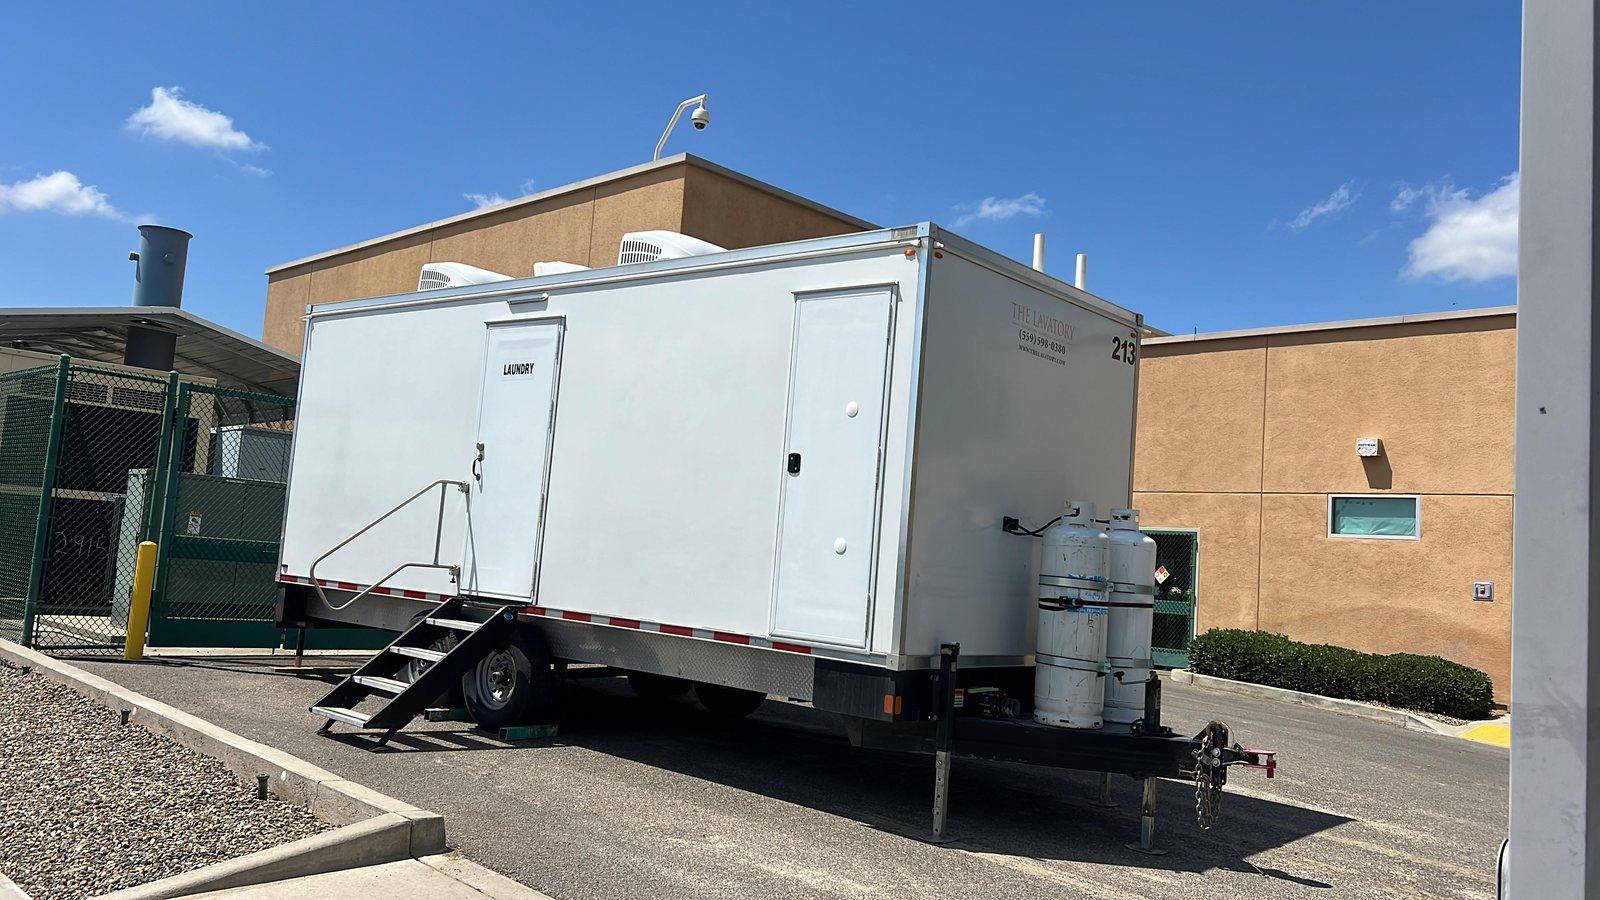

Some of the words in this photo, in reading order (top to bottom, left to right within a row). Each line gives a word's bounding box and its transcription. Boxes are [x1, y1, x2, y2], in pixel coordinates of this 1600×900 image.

[1011, 302, 1031, 324] THE
[1033, 311, 1075, 341] LAVATORY
[1111, 336, 1136, 366] 213
[503, 362, 535, 376] LAUNDRY
